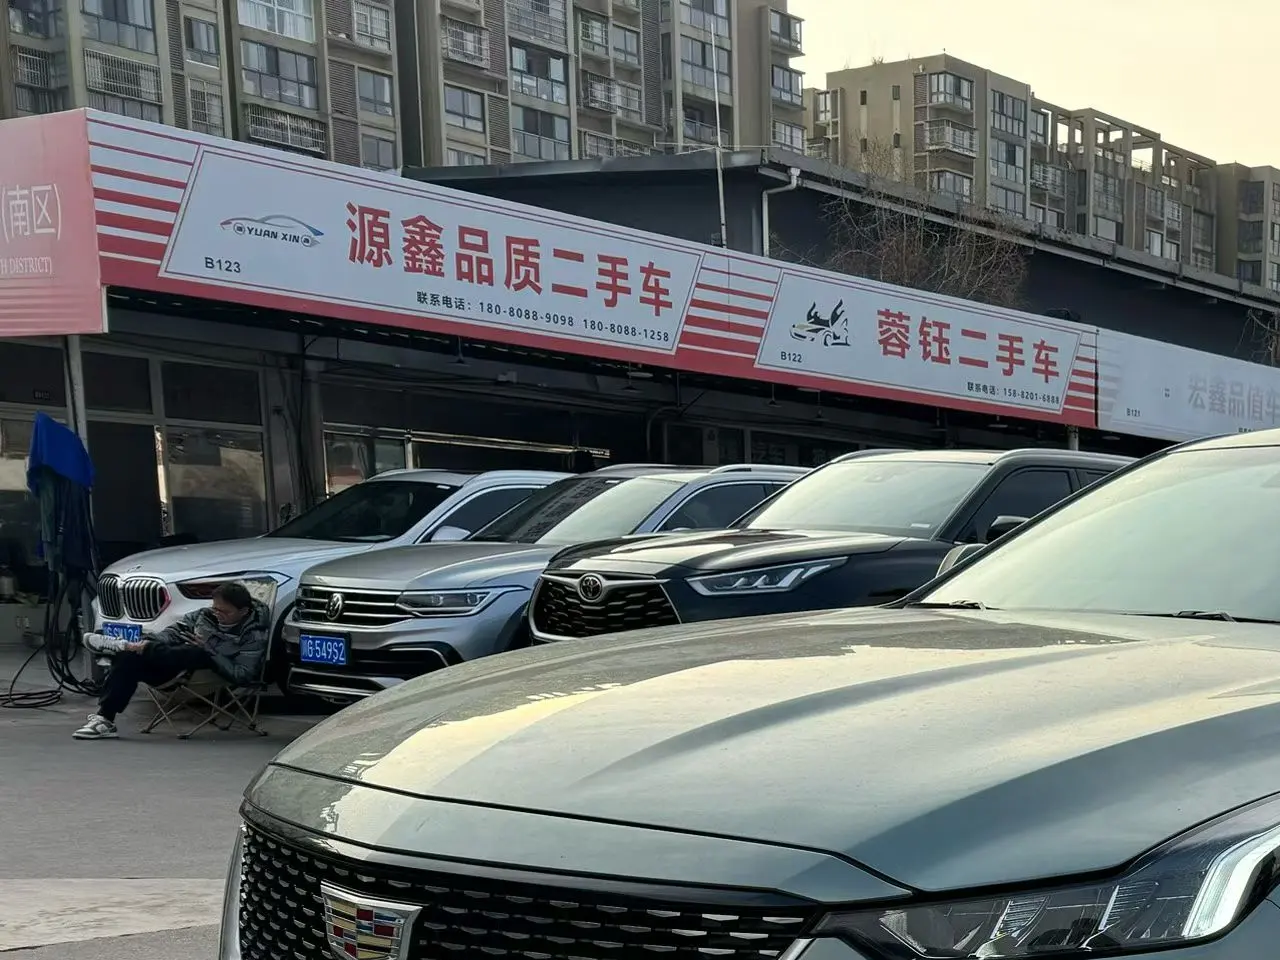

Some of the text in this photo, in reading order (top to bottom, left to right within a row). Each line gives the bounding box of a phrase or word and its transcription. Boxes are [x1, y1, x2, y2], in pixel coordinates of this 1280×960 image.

[246, 226, 300, 243] YUAN XIN
[204, 256, 241, 273] B123
[346, 201, 674, 316] 源鑫品质二手车
[479, 301, 575, 327] 180-8088-9098
[583, 319, 669, 342] 180-8088-1258
[876, 308, 1061, 384] 蓉钰二手车
[780, 351, 803, 363] B122
[1126, 407, 1141, 417] B121
